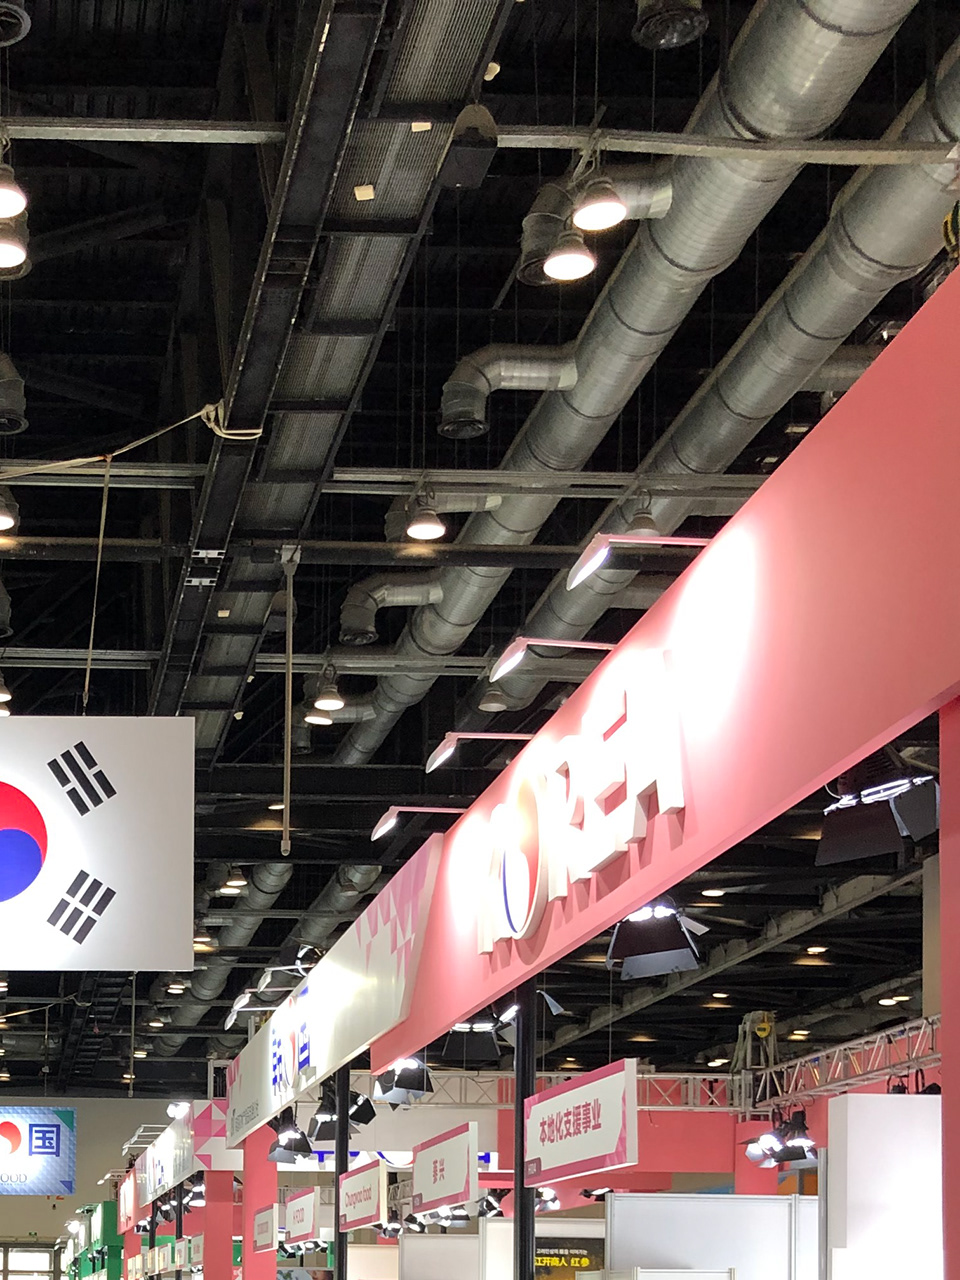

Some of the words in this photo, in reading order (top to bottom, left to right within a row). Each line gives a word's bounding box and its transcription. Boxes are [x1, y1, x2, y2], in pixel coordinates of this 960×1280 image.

[538, 1097, 602, 1147] 本地化支援事业
